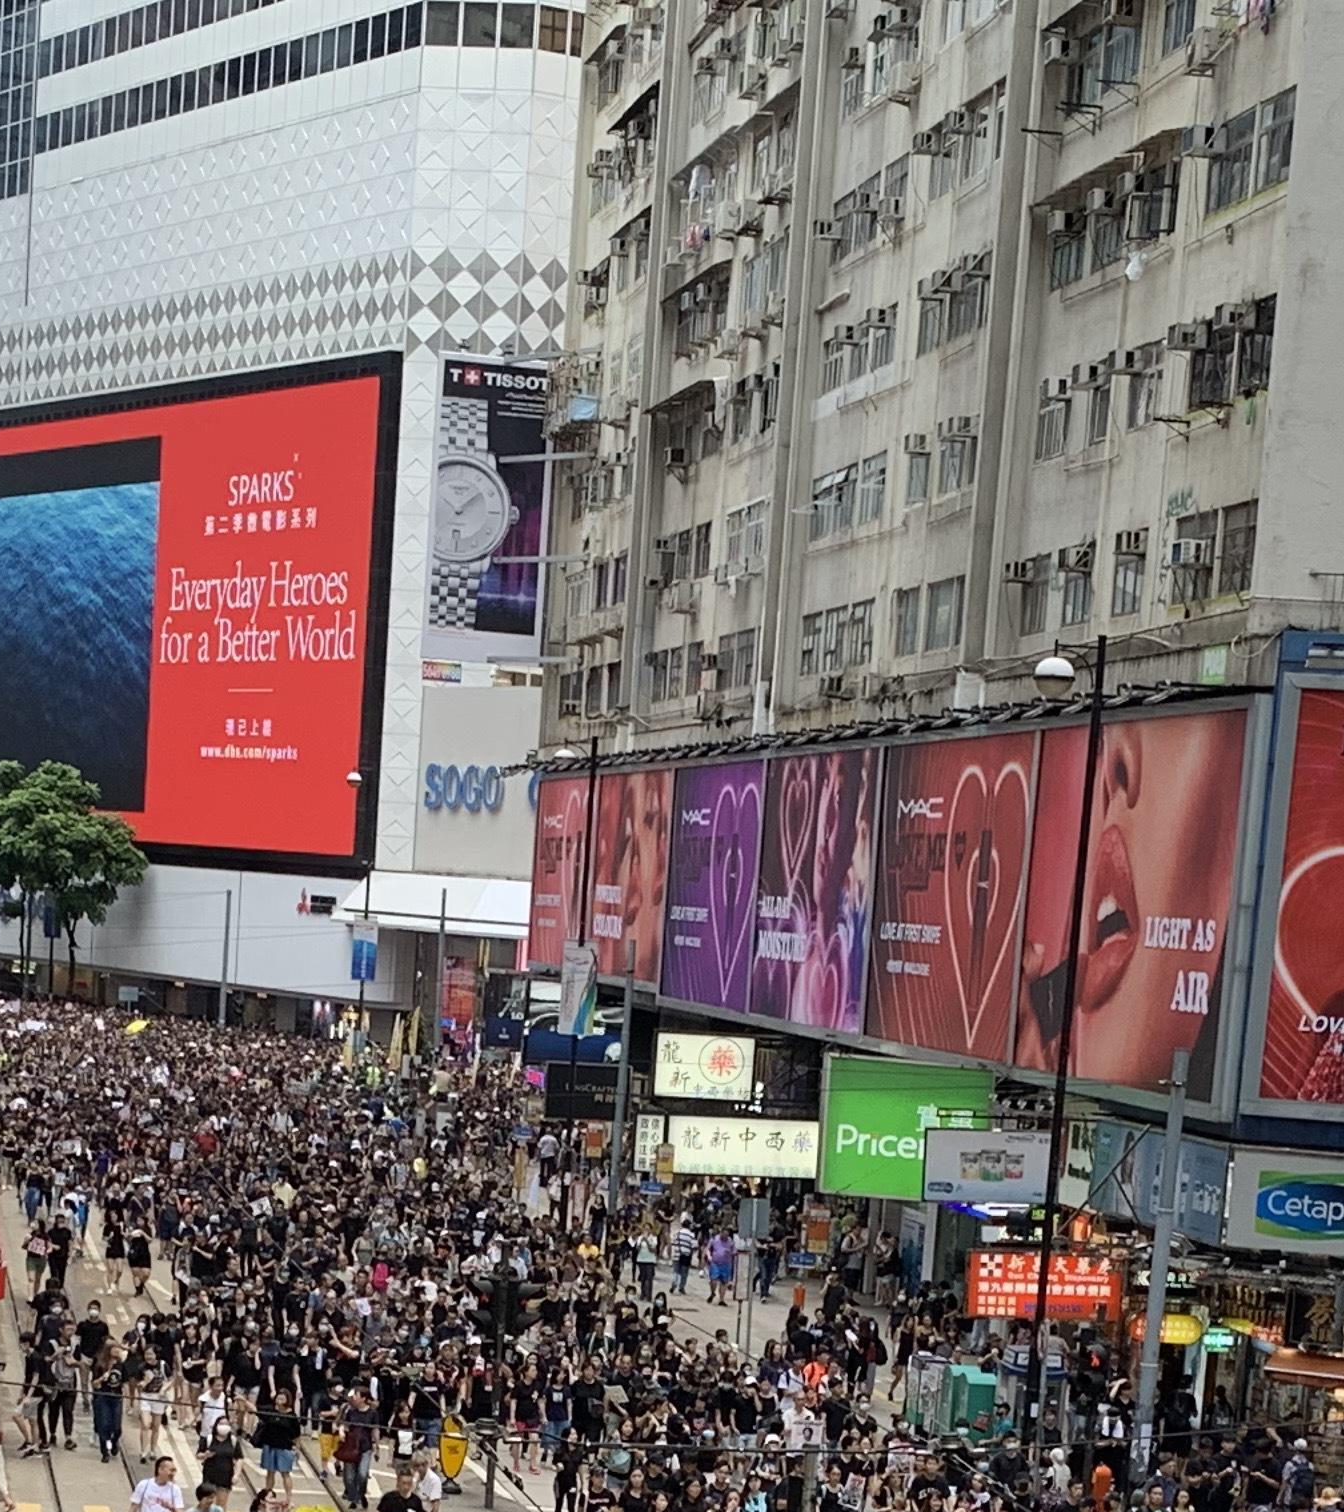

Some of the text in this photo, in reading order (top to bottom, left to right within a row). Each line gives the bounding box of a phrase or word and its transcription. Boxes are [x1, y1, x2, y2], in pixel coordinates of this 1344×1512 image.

[483, 371, 551, 391] TISSOT
[228, 470, 295, 507] SPARKS
[169, 560, 349, 625] Everyday Heroes
[159, 610, 357, 664] for a Better World
[424, 762, 505, 813] SOGO
[681, 808, 712, 827] MAC
[897, 797, 945, 819] MAC
[1144, 916, 1217, 952] LIGHT AS
[1170, 969, 1211, 1015] AIR
